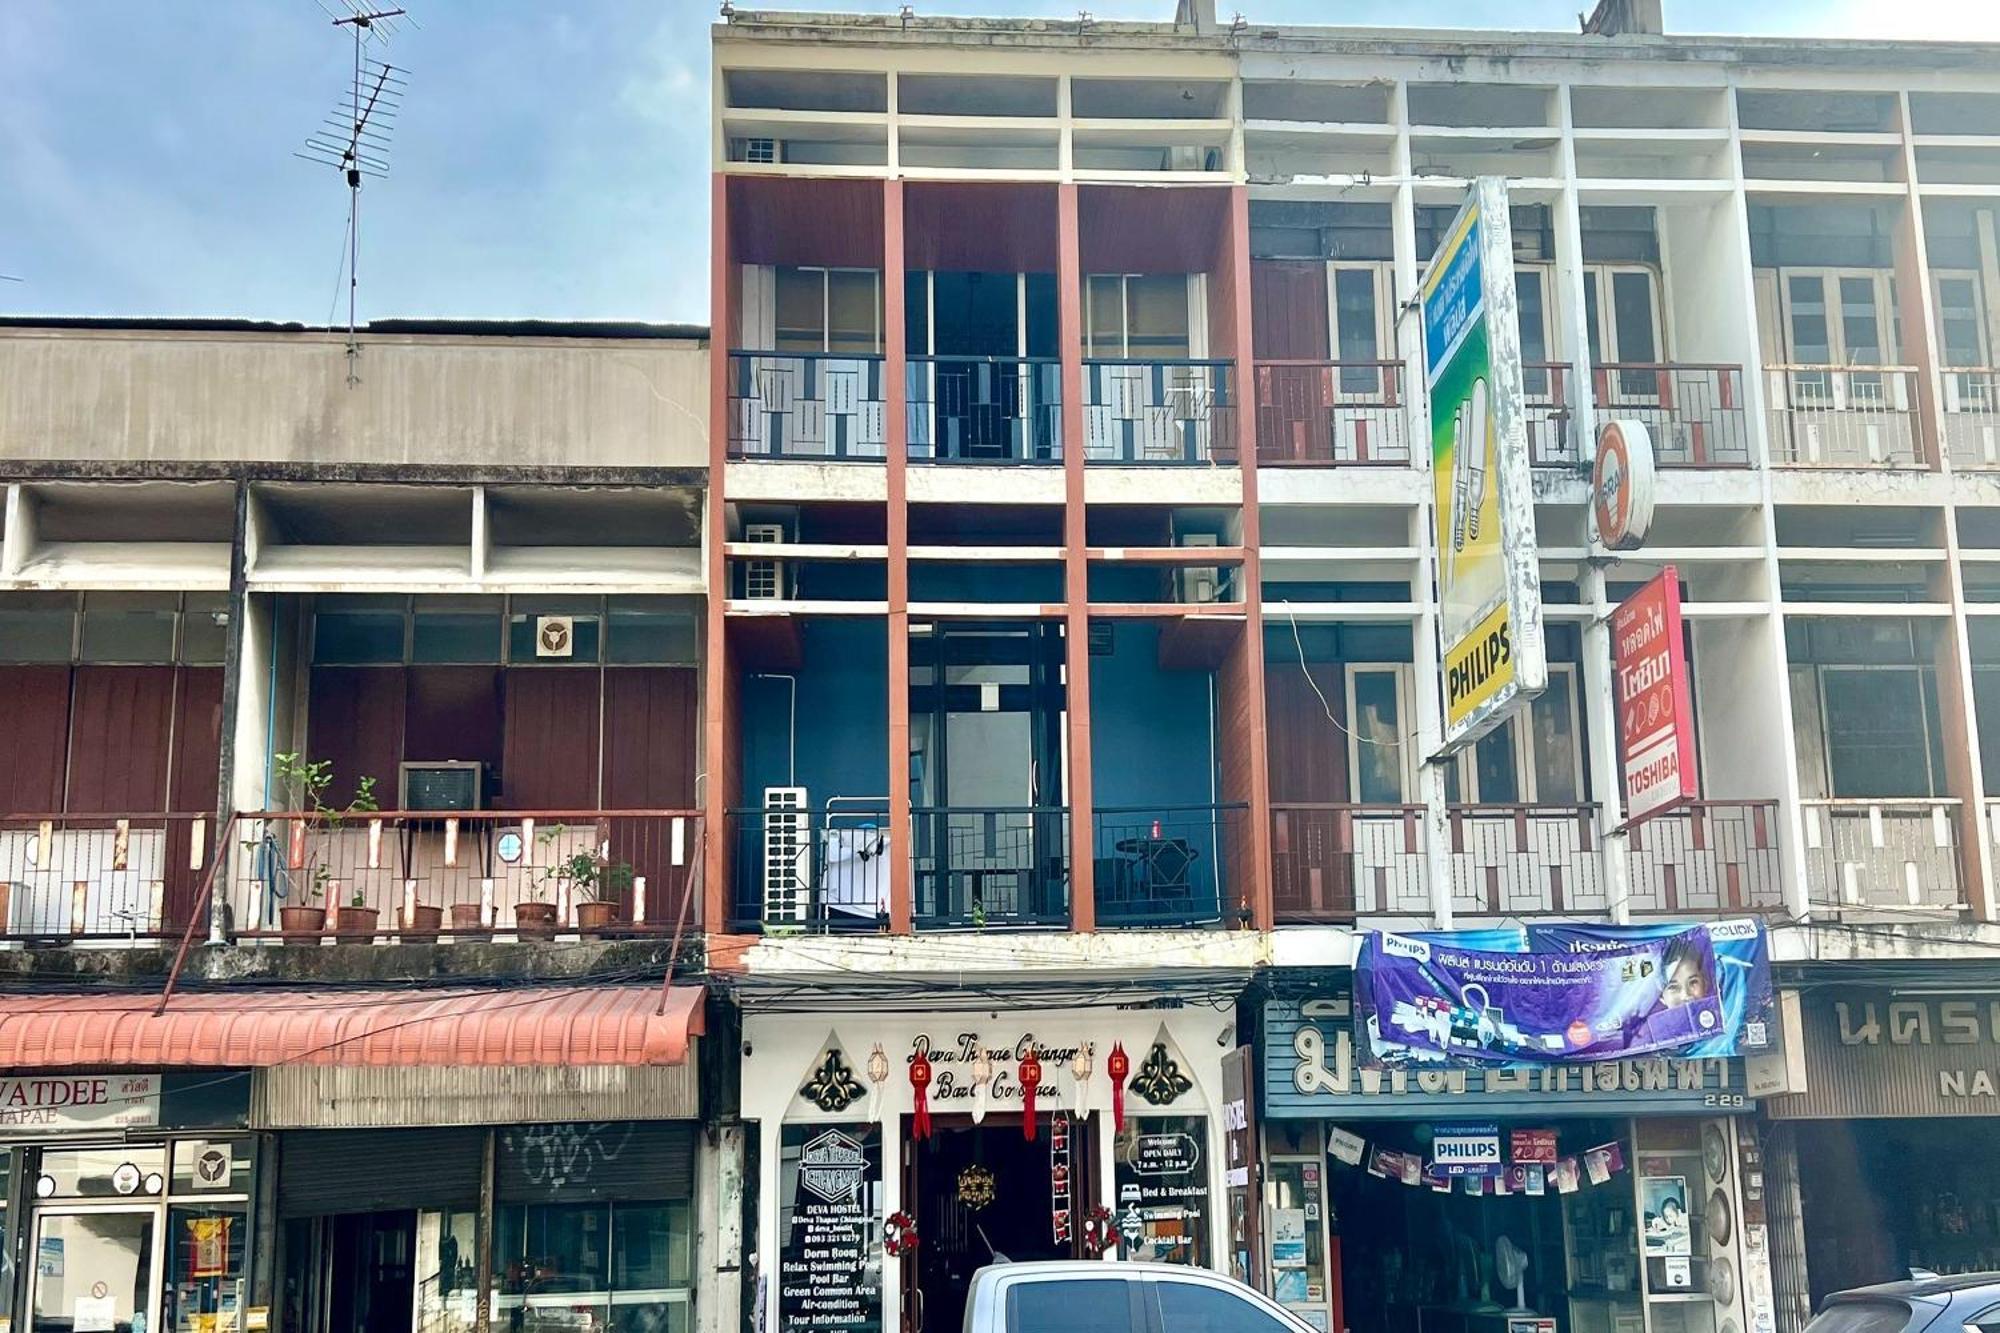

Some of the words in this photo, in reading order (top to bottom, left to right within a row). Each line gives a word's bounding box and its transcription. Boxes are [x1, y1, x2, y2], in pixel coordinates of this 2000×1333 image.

[1622, 601, 1664, 658] หลอดไฟ
[1449, 622, 1510, 707] PHILIPS
[1620, 650, 1671, 702] โตชิบา
[1628, 752, 1678, 796] TOSHIBA
[1540, 960, 1547, 973] 1
[1835, 1001, 2000, 1046] นคร
[905, 1034, 954, 1063] Deva
[957, 1033, 1012, 1063] Thpae
[1015, 1033, 1094, 1067] Chiangmi
[1704, 1094, 1744, 1107] 229
[1147, 1138, 1177, 1147] Welcome
[1143, 1149, 1162, 1158] OPEN
[1163, 1148, 1182, 1157] DAILY
[1437, 1143, 1497, 1157] PHILIPS
[1448, 1166, 1464, 1174] LED
[1142, 1187, 1159, 1197] Bed
[1160, 1188, 1166, 1196] &
[1168, 1186, 1208, 1197] Breakfast
[807, 1205, 829, 1214] DEVA
[830, 1204, 862, 1214] HOSTEL
[1143, 1210, 1182, 1220] Swimming
[1183, 1208, 1200, 1218] Pool
[1143, 1235, 1176, 1245] Cocktail
[1177, 1235, 1193, 1244] Bar
[804, 1248, 829, 1259] Dorm
[831, 1247, 858, 1259] Room
[783, 1262, 808, 1272] Relax
[810, 1260, 857, 1272] Swimming
[859, 1259, 880, 1270] Pool
[809, 1273, 830, 1284] Pool
[831, 1273, 849, 1284] Bar
[783, 1286, 811, 1297] Green
[813, 1286, 853, 1296] Common
[855, 1285, 876, 1295] Area
[801, 1298, 860, 1310] Air-condition
[788, 1314, 810, 1325] Tour
[812, 1312, 866, 1325] Information
